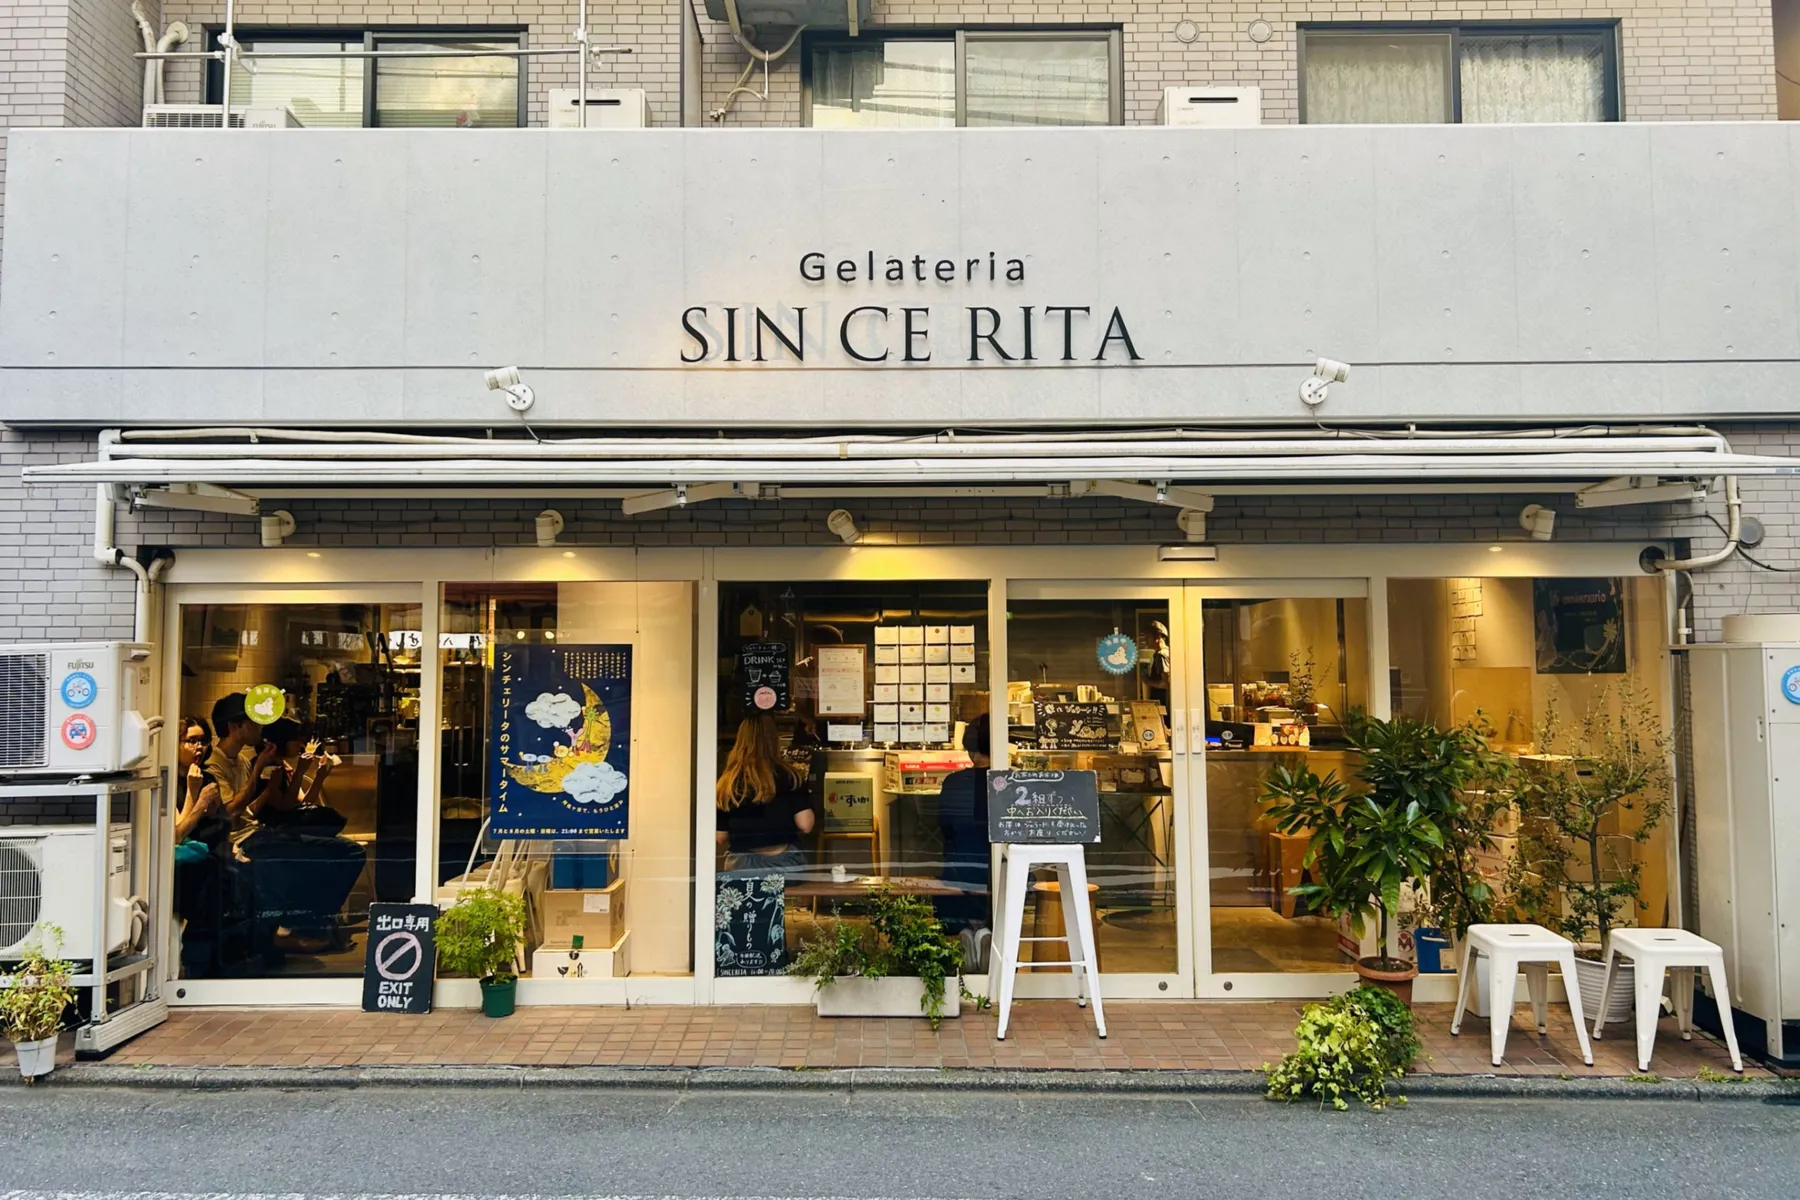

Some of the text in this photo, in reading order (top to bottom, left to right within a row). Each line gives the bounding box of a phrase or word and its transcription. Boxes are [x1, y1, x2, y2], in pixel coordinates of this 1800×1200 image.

[799, 250, 1026, 283] Gelateria
[67, 661, 94, 670] FUJITSU
[744, 655, 775, 665] DRINK
[498, 651, 513, 813] シンチェリータのサマータイム
[740, 877, 765, 950] 夏の贈りもの
[376, 913, 430, 932] 出口専用
[379, 981, 413, 995] EXIT
[377, 995, 413, 1009] ONLY
